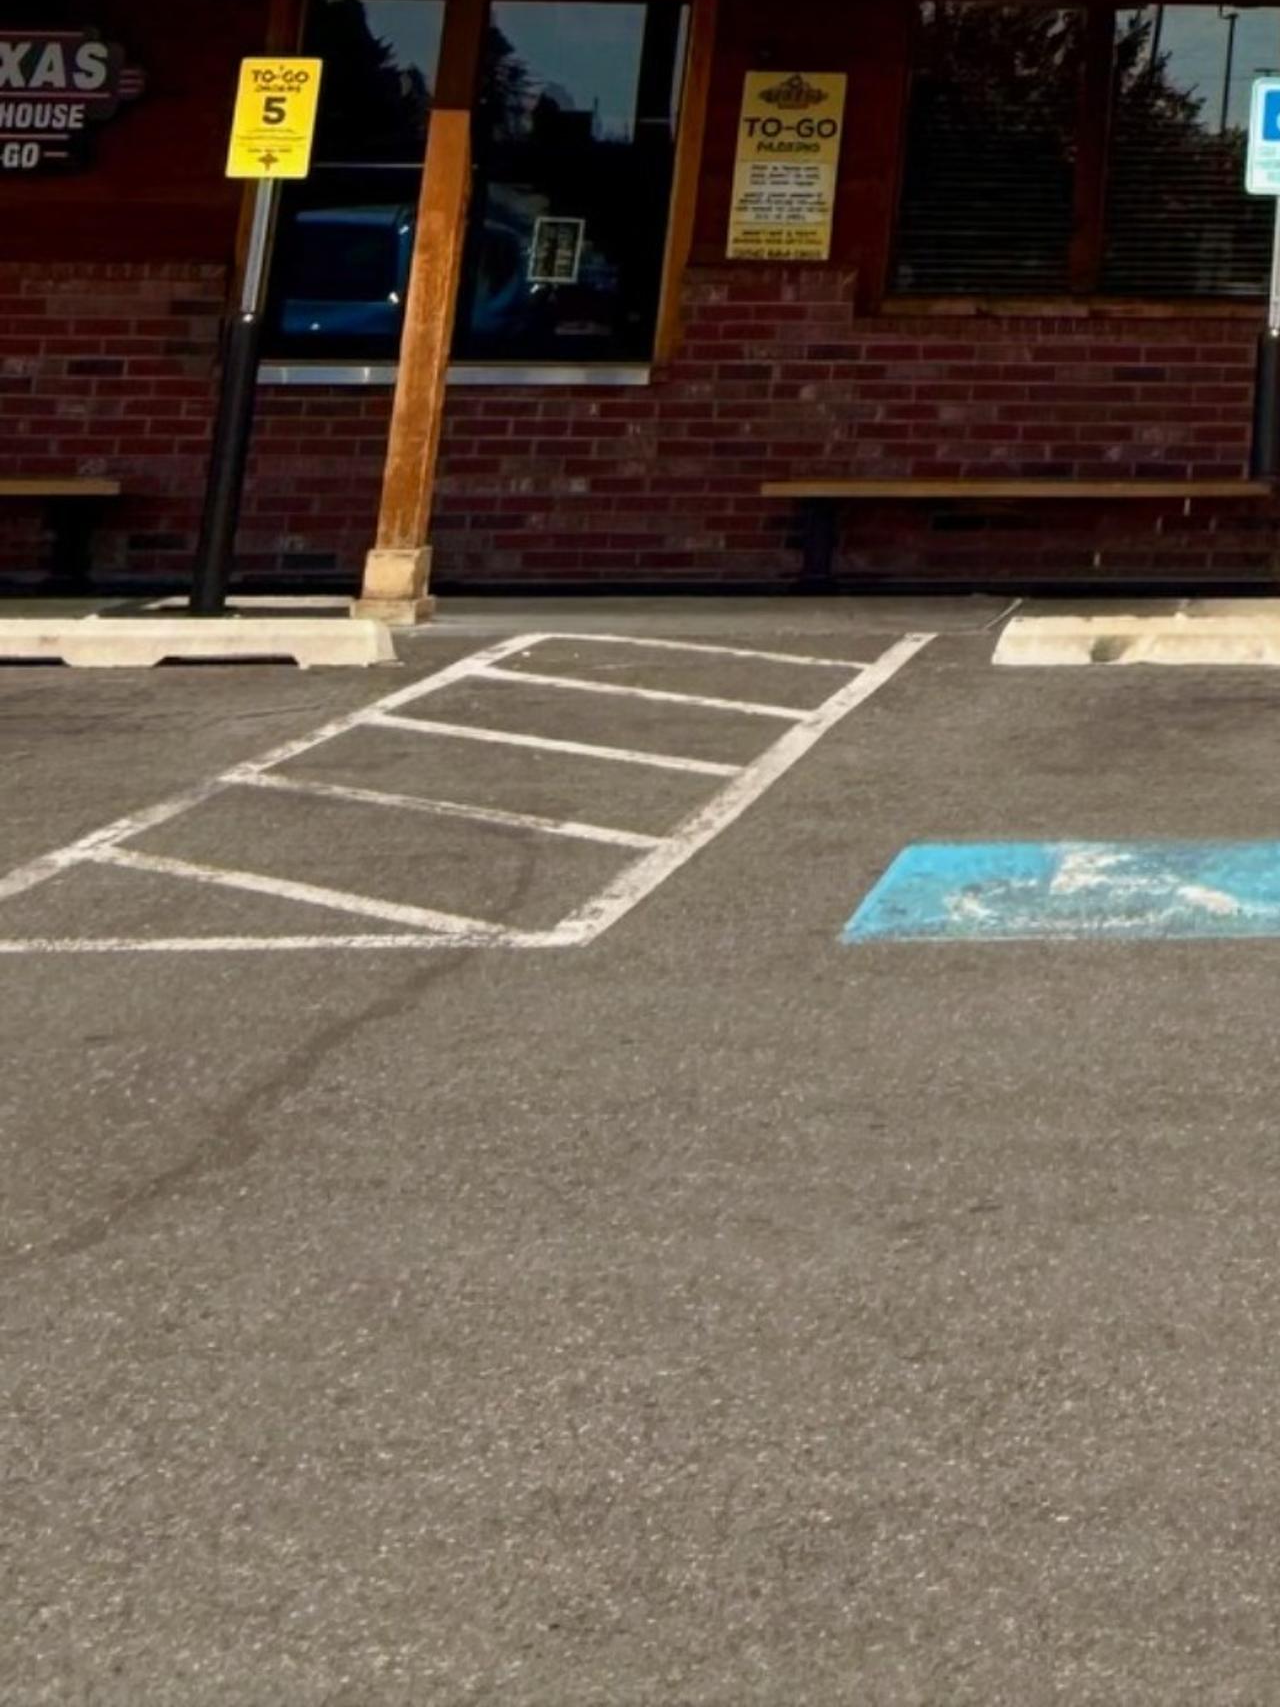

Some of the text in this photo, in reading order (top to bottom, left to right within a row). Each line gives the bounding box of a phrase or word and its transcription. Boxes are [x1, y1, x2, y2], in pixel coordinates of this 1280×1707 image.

[0, 41, 109, 89] XAS
[251, 69, 309, 84] TO-GO
[262, 95, 287, 125] 5
[743, 117, 838, 139] TO-GO
